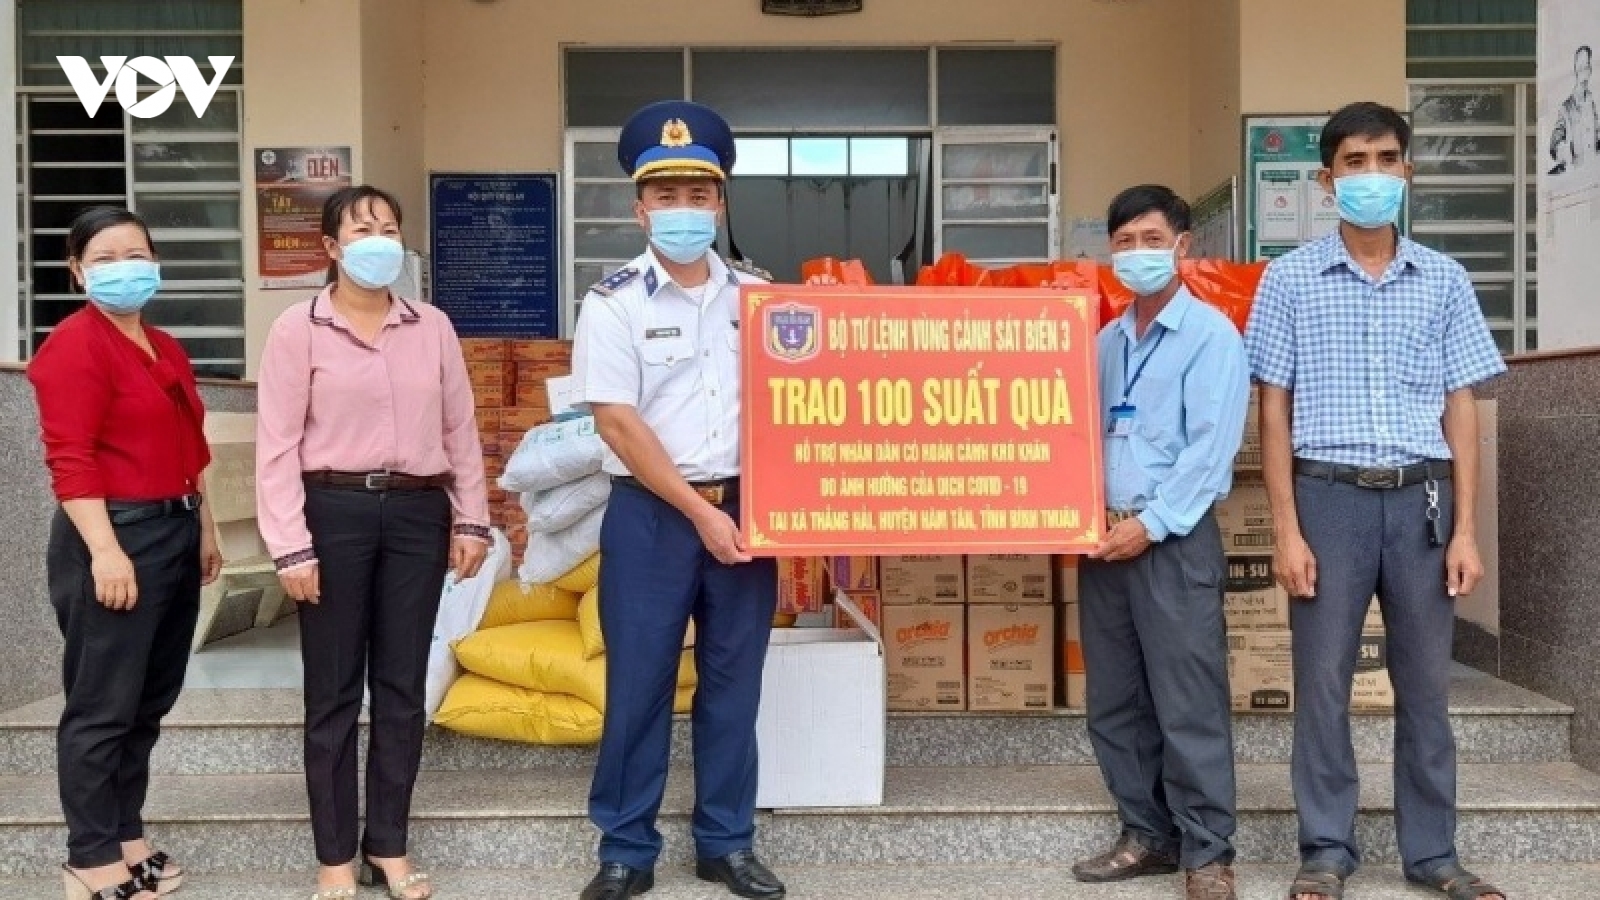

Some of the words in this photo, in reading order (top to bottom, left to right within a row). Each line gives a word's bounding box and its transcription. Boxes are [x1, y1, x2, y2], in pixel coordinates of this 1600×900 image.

[827, 311, 849, 359] BỘ
[851, 315, 871, 352] TƯ
[872, 311, 909, 359] LỆNH
[911, 312, 950, 352] VÙNG
[953, 308, 992, 352] CẢNH
[995, 312, 1021, 352] SÁT
[1061, 319, 1071, 352] 3
[767, 377, 847, 427] TRAO
[857, 377, 913, 427] 100
[922, 360, 1001, 427] SUẤT
[1010, 367, 1074, 431] QUÀ
[813, 441, 837, 467] TRỢ
[839, 439, 873, 463] NHÂN
[875, 438, 901, 463] DÂN
[903, 437, 919, 463] CÓ
[921, 439, 955, 463] HOÀN
[957, 438, 989, 463] CẢNH
[991, 439, 1015, 463] KHÓ
[1018, 438, 1051, 463] KHĂN
[820, 477, 837, 497] DO
[840, 470, 865, 497] ẢNH
[867, 470, 909, 497] HƯỞNG
[911, 470, 935, 497] CỦA
[937, 475, 965, 500] DỊCH
[967, 475, 1003, 497] COVID
[1012, 475, 1029, 497] 19
[767, 511, 789, 537] TẠI
[790, 507, 807, 531] XÃ
[879, 506, 918, 535] HUYỆN
[980, 503, 1007, 530] TỈNH
[1009, 506, 1039, 530] BÌNH
[1040, 505, 1081, 533] THUẬN
